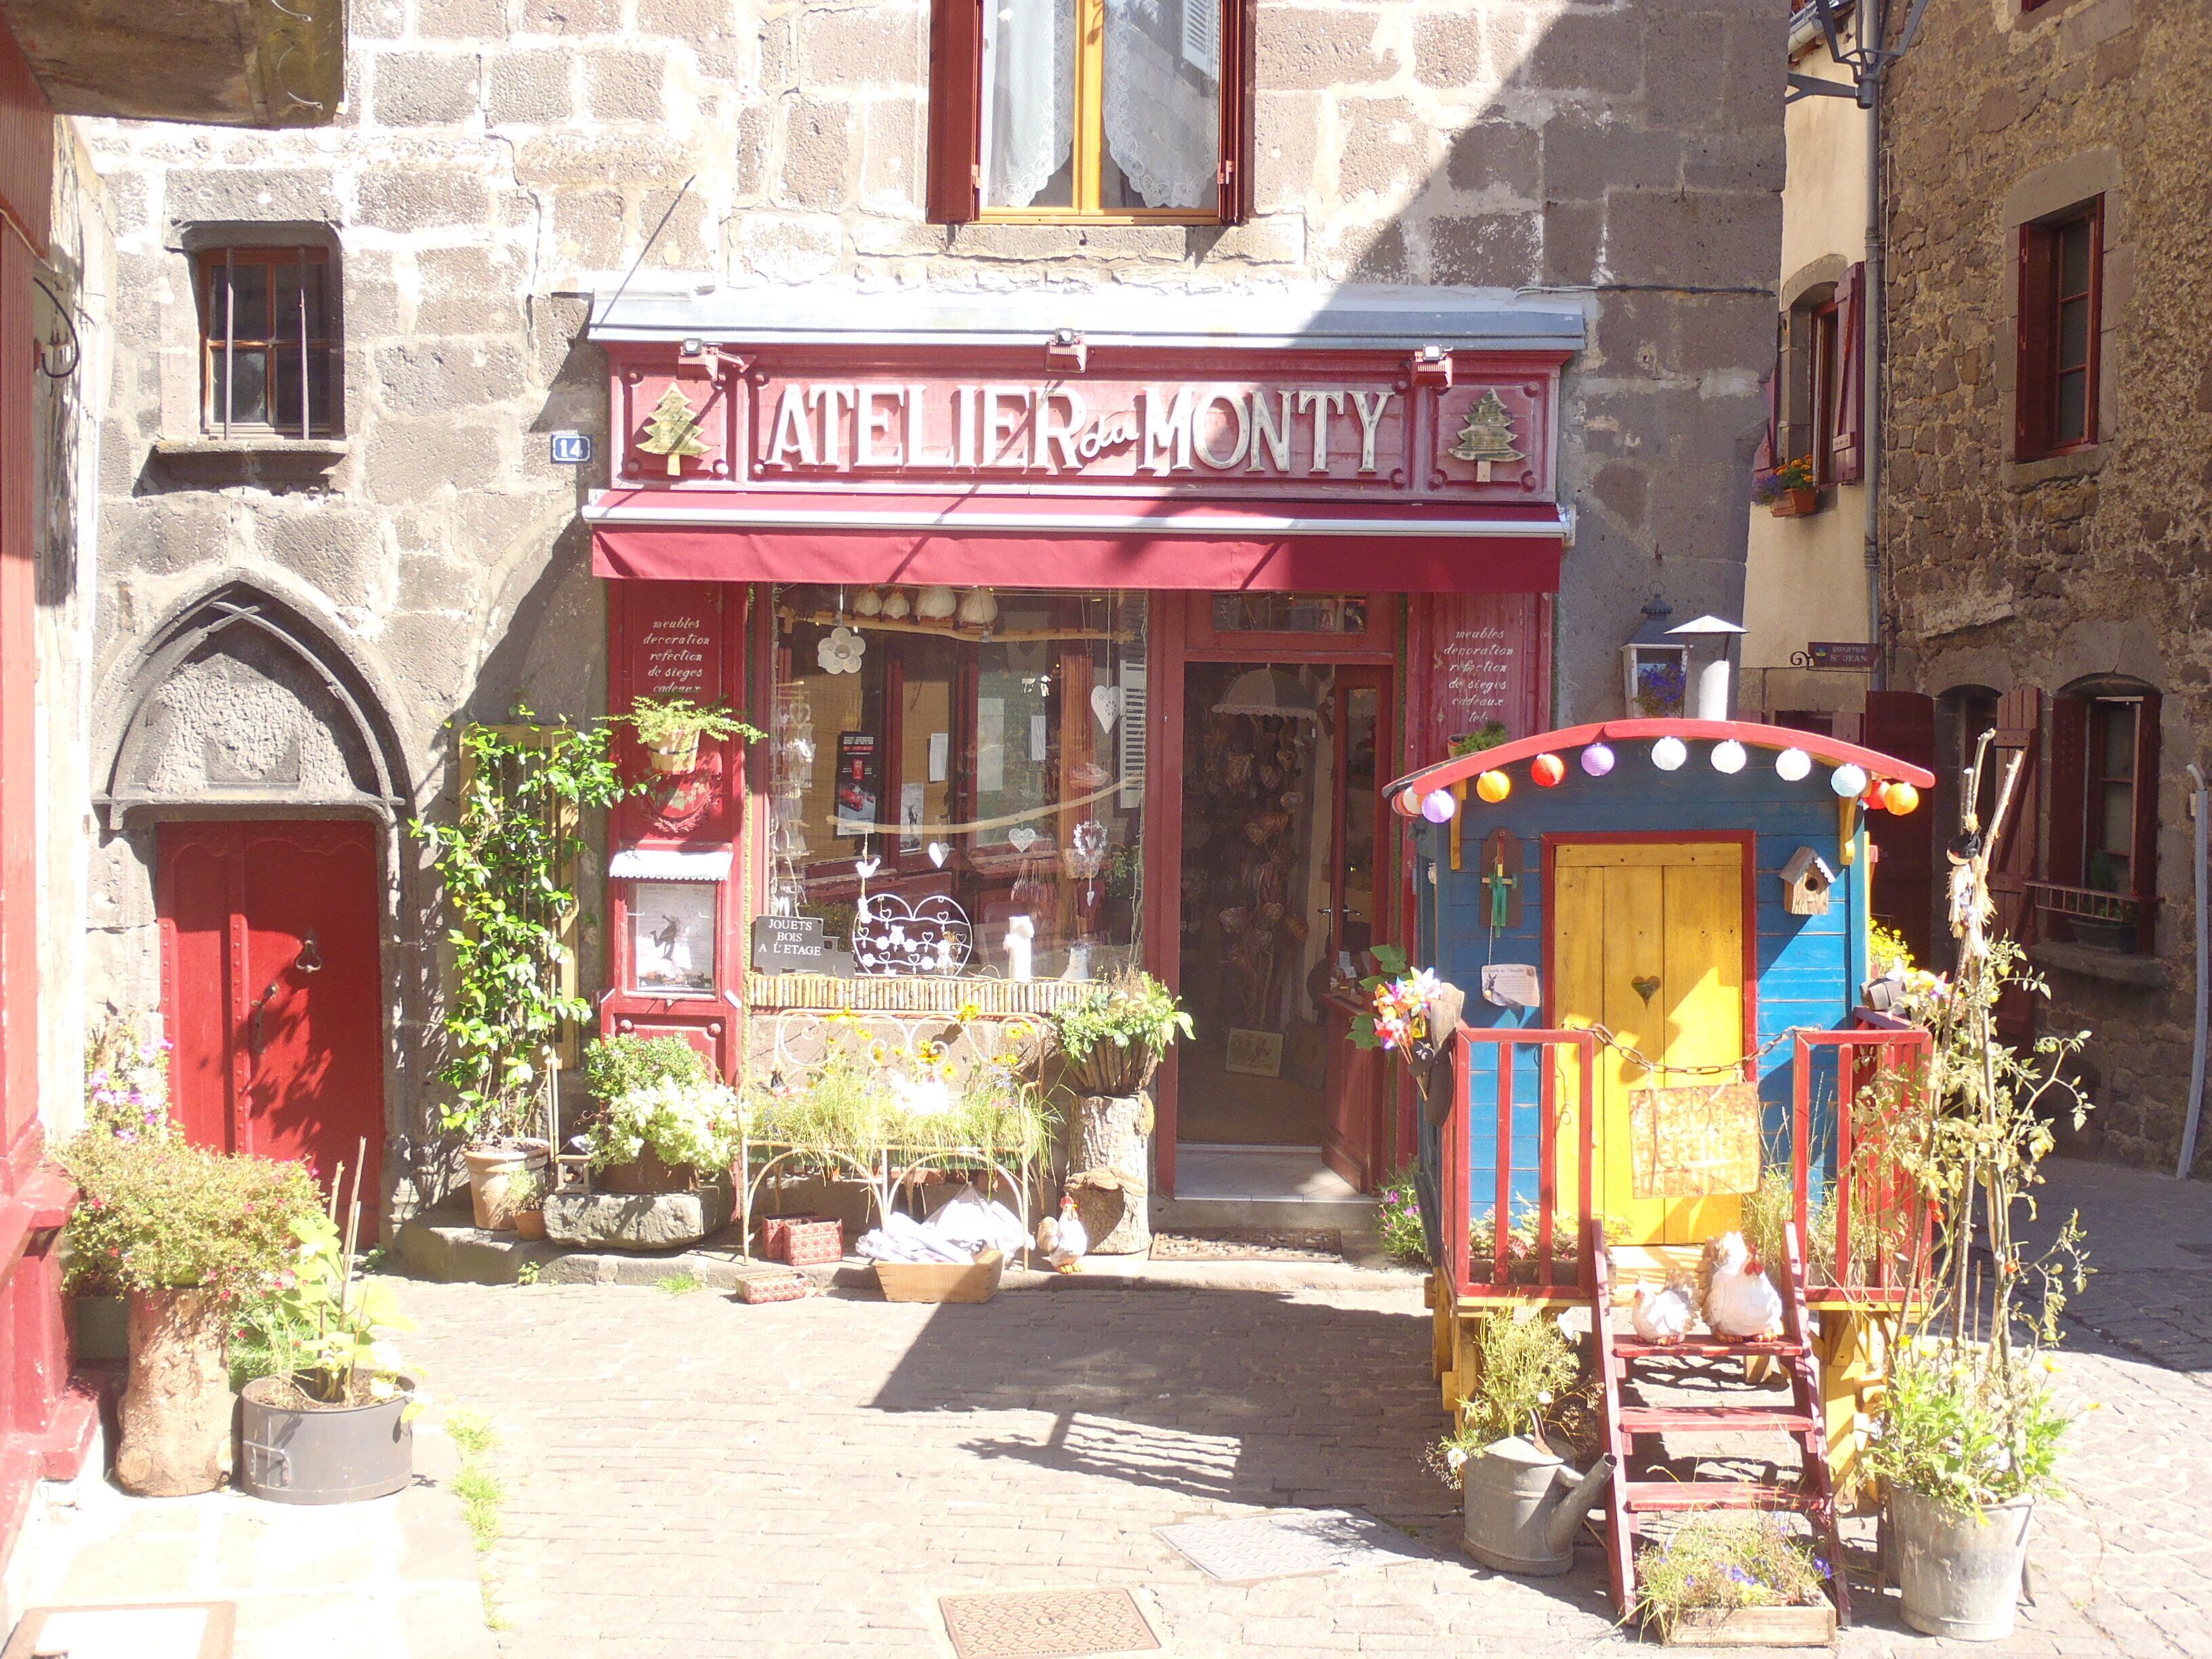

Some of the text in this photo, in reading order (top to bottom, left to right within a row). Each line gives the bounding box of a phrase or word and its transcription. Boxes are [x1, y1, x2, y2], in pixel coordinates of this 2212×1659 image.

[764, 384, 1395, 472] ATELIER du MONTY
[560, 439, 583, 457] 14
[653, 617, 700, 628] meubles
[1456, 627, 1504, 638] meubles
[643, 633, 710, 644] decoration
[1443, 643, 1513, 655] decoration
[649, 649, 702, 661] refection
[648, 665, 703, 682] de sieges
[1449, 677, 1507, 694] de sieges
[1452, 695, 1504, 706] cadeaux
[769, 919, 813, 930] JOUETS
[777, 932, 802, 942] BOIS
[758, 943, 767, 952] A
